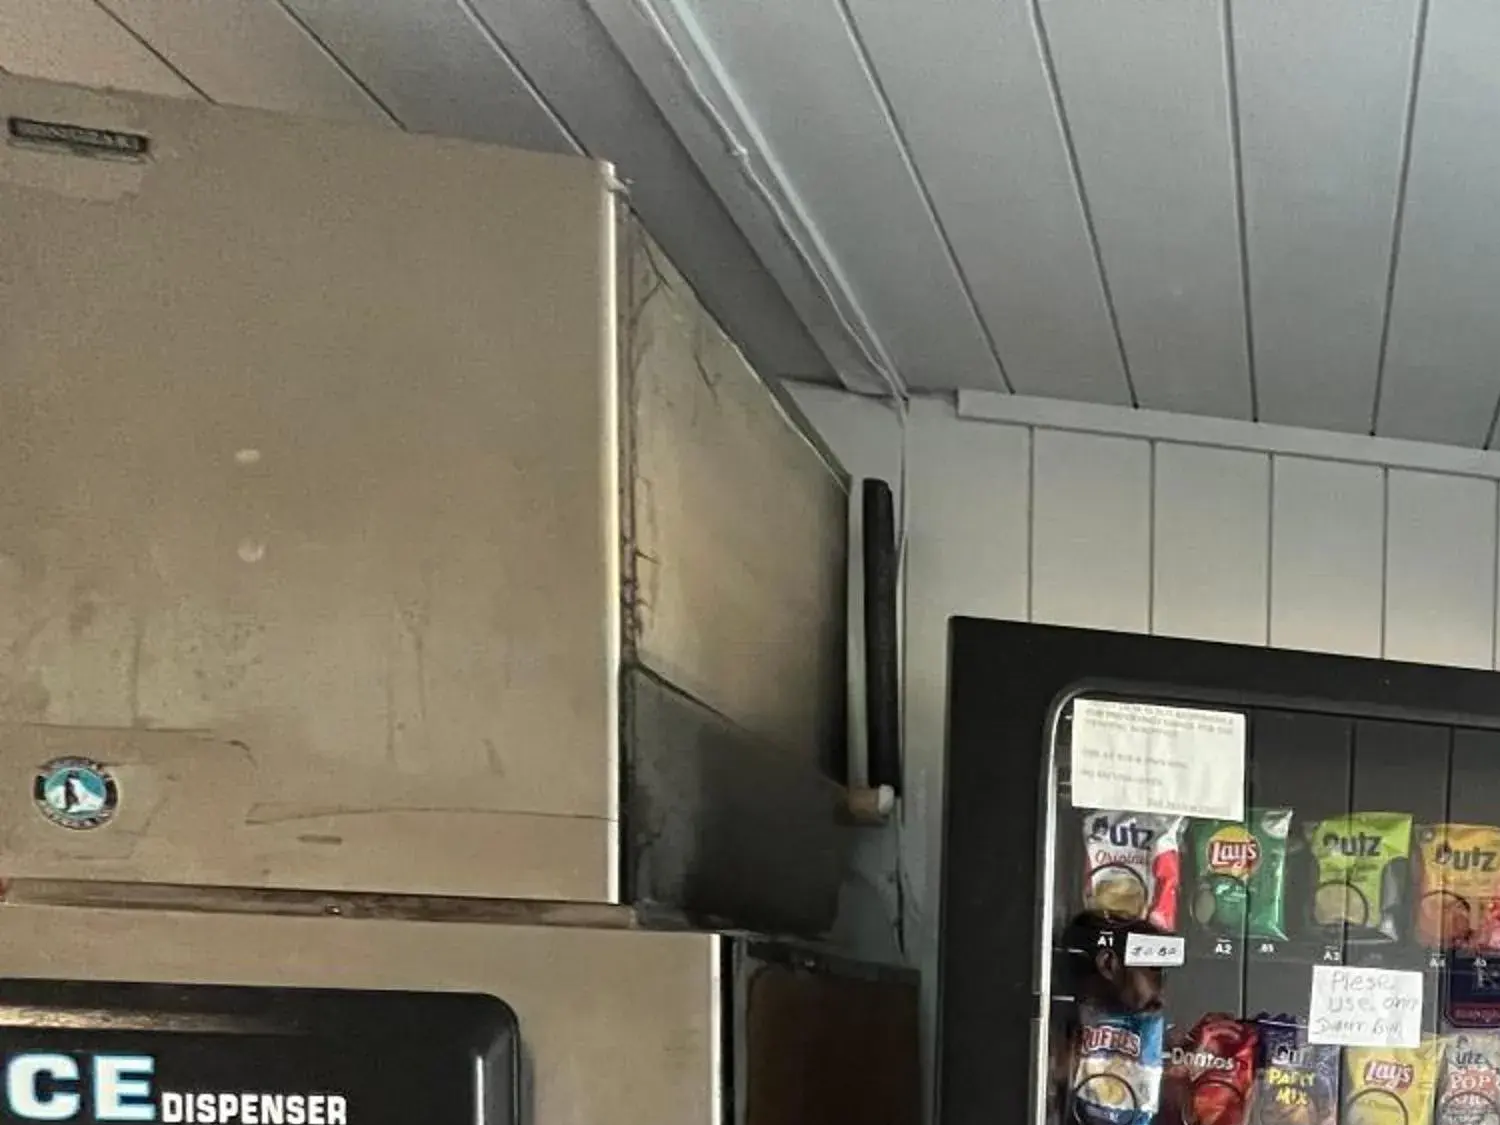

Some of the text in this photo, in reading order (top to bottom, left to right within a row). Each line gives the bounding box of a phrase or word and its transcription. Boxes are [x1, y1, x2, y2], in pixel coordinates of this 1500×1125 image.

[1171, 1047, 1236, 1072] Doritos
[1268, 1068, 1316, 1086] PARTY
[1275, 1087, 1310, 1106] MIX
[161, 1092, 347, 1125] DISPENSER
